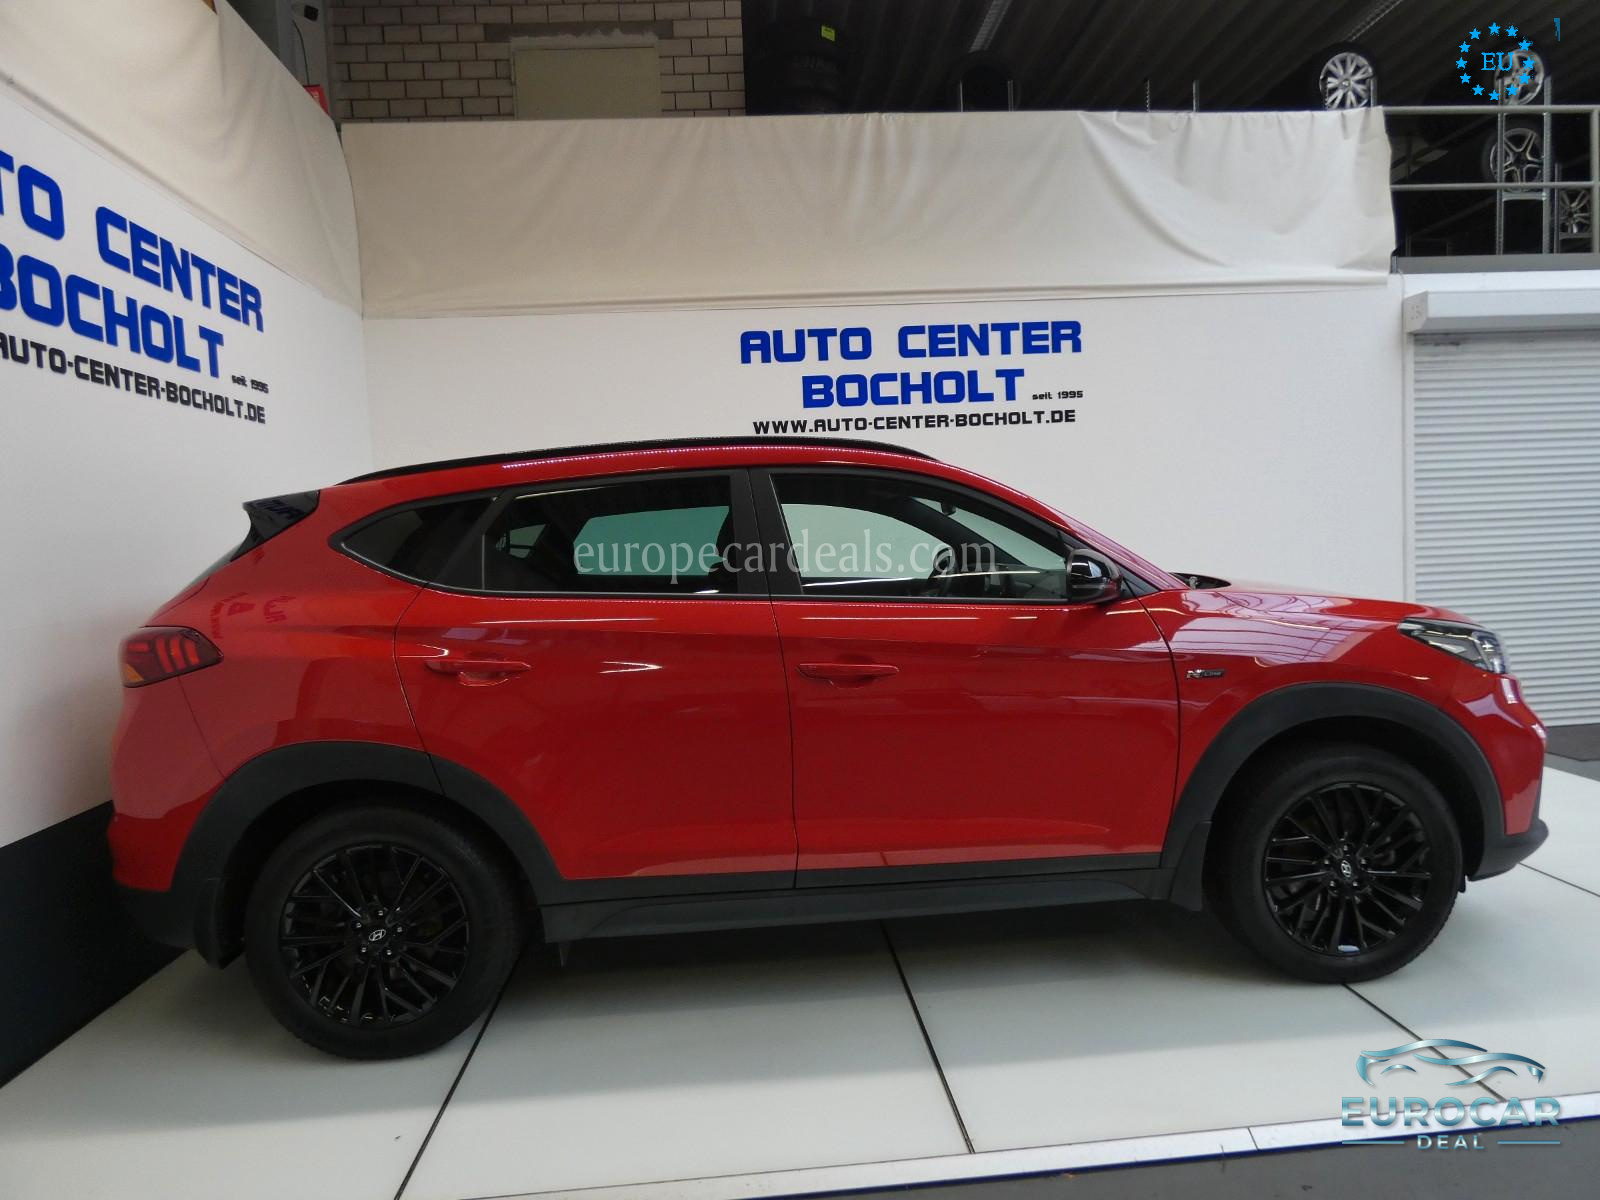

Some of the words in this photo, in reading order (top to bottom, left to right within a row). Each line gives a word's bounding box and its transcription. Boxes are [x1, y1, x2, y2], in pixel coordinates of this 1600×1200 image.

[95, 206, 264, 332] CENTER
[740, 327, 872, 364] AUTO
[898, 321, 1082, 358] CENTER
[802, 368, 1025, 408] BOCHOLT
[1032, 392, 1053, 400] seit
[1057, 390, 1084, 399] 1995
[753, 409, 1076, 434] WWW.AUTO-CENTER-BOCHOLT.DE
